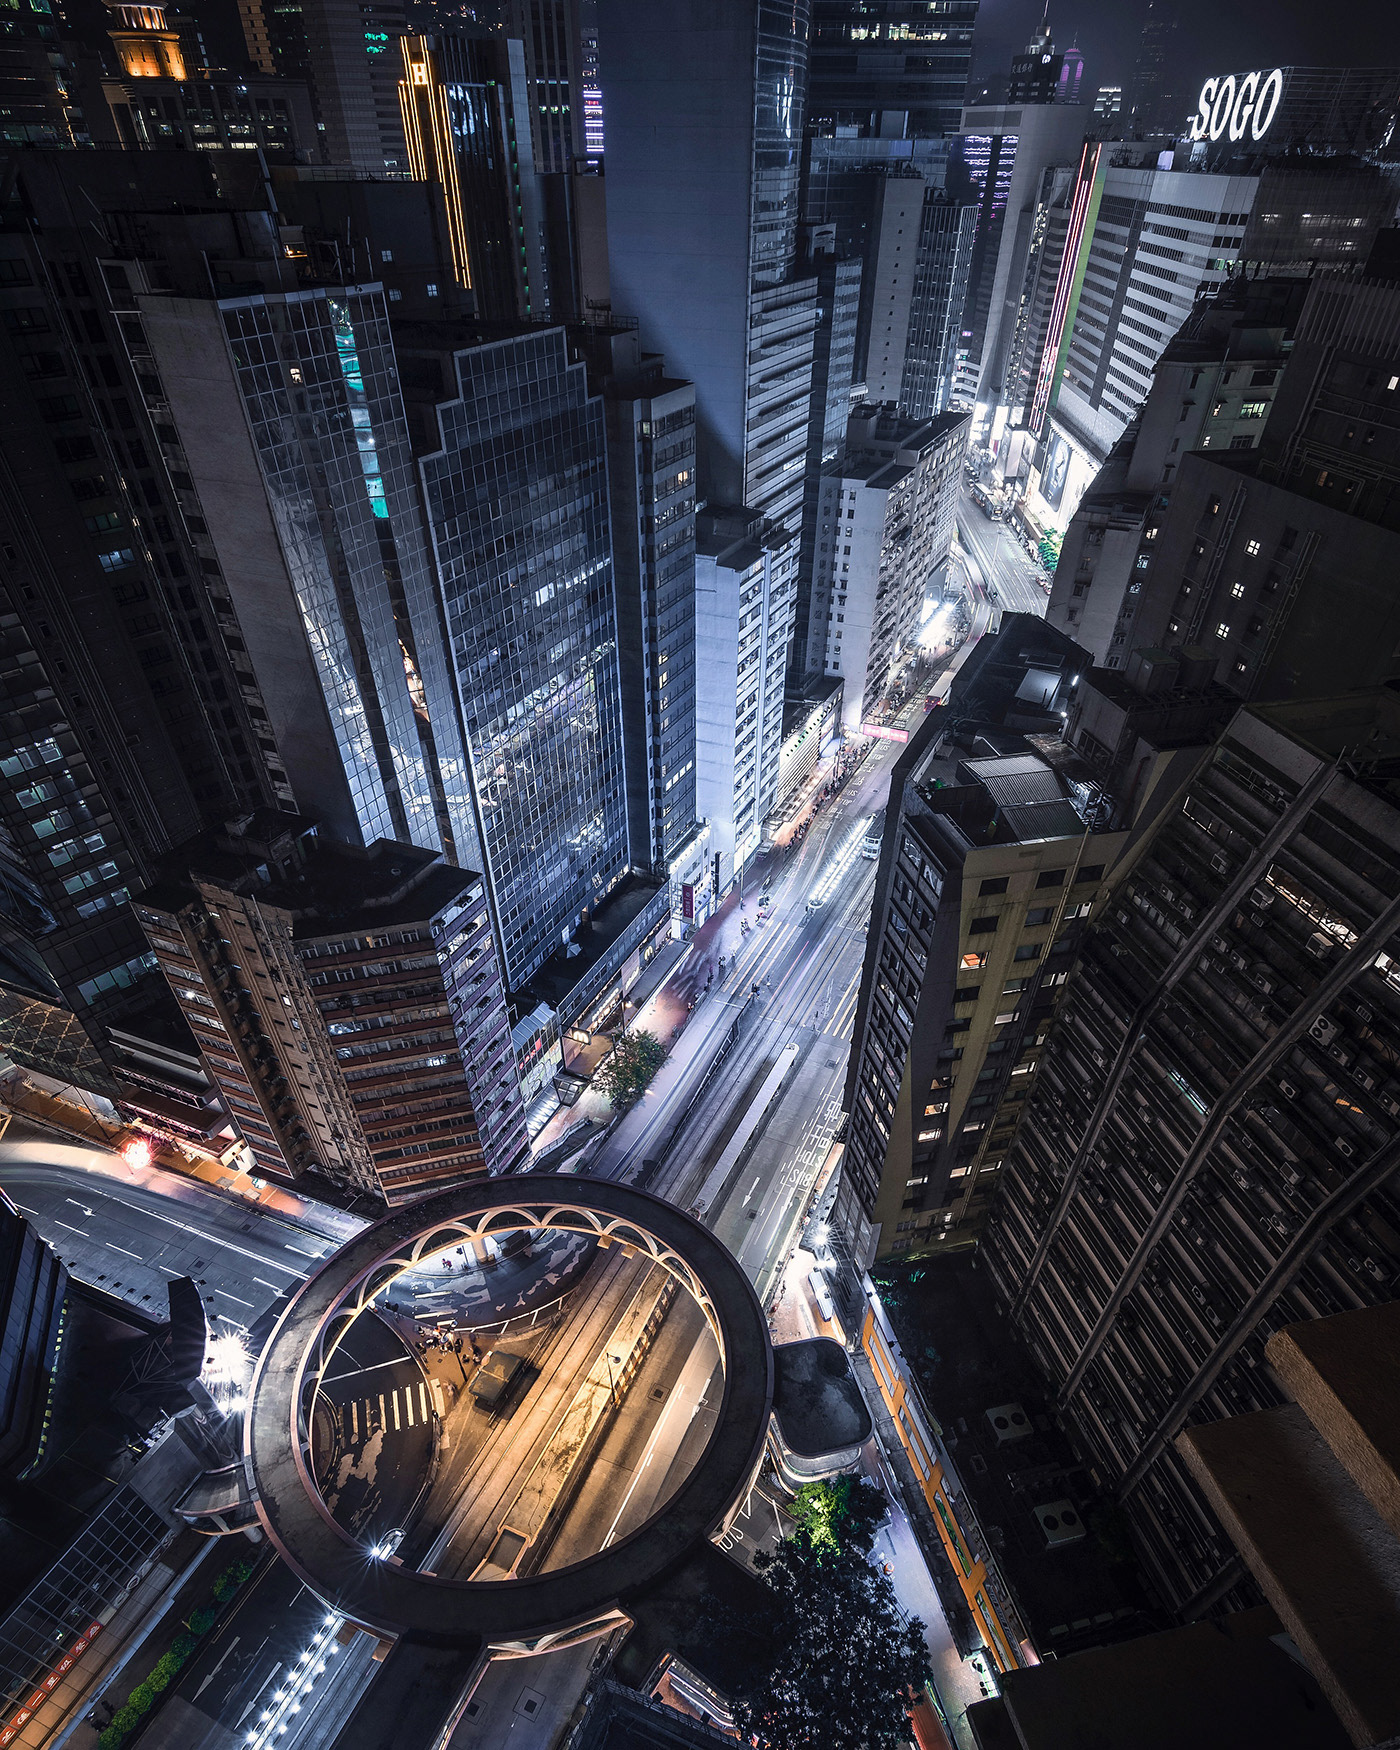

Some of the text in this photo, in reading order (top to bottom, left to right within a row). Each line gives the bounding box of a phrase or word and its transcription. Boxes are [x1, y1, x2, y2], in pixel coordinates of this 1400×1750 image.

[411, 63, 428, 85] H
[1188, 68, 1283, 142] SOGO
[798, 1149, 825, 1168] STOP
[789, 1168, 812, 1187] BUS
